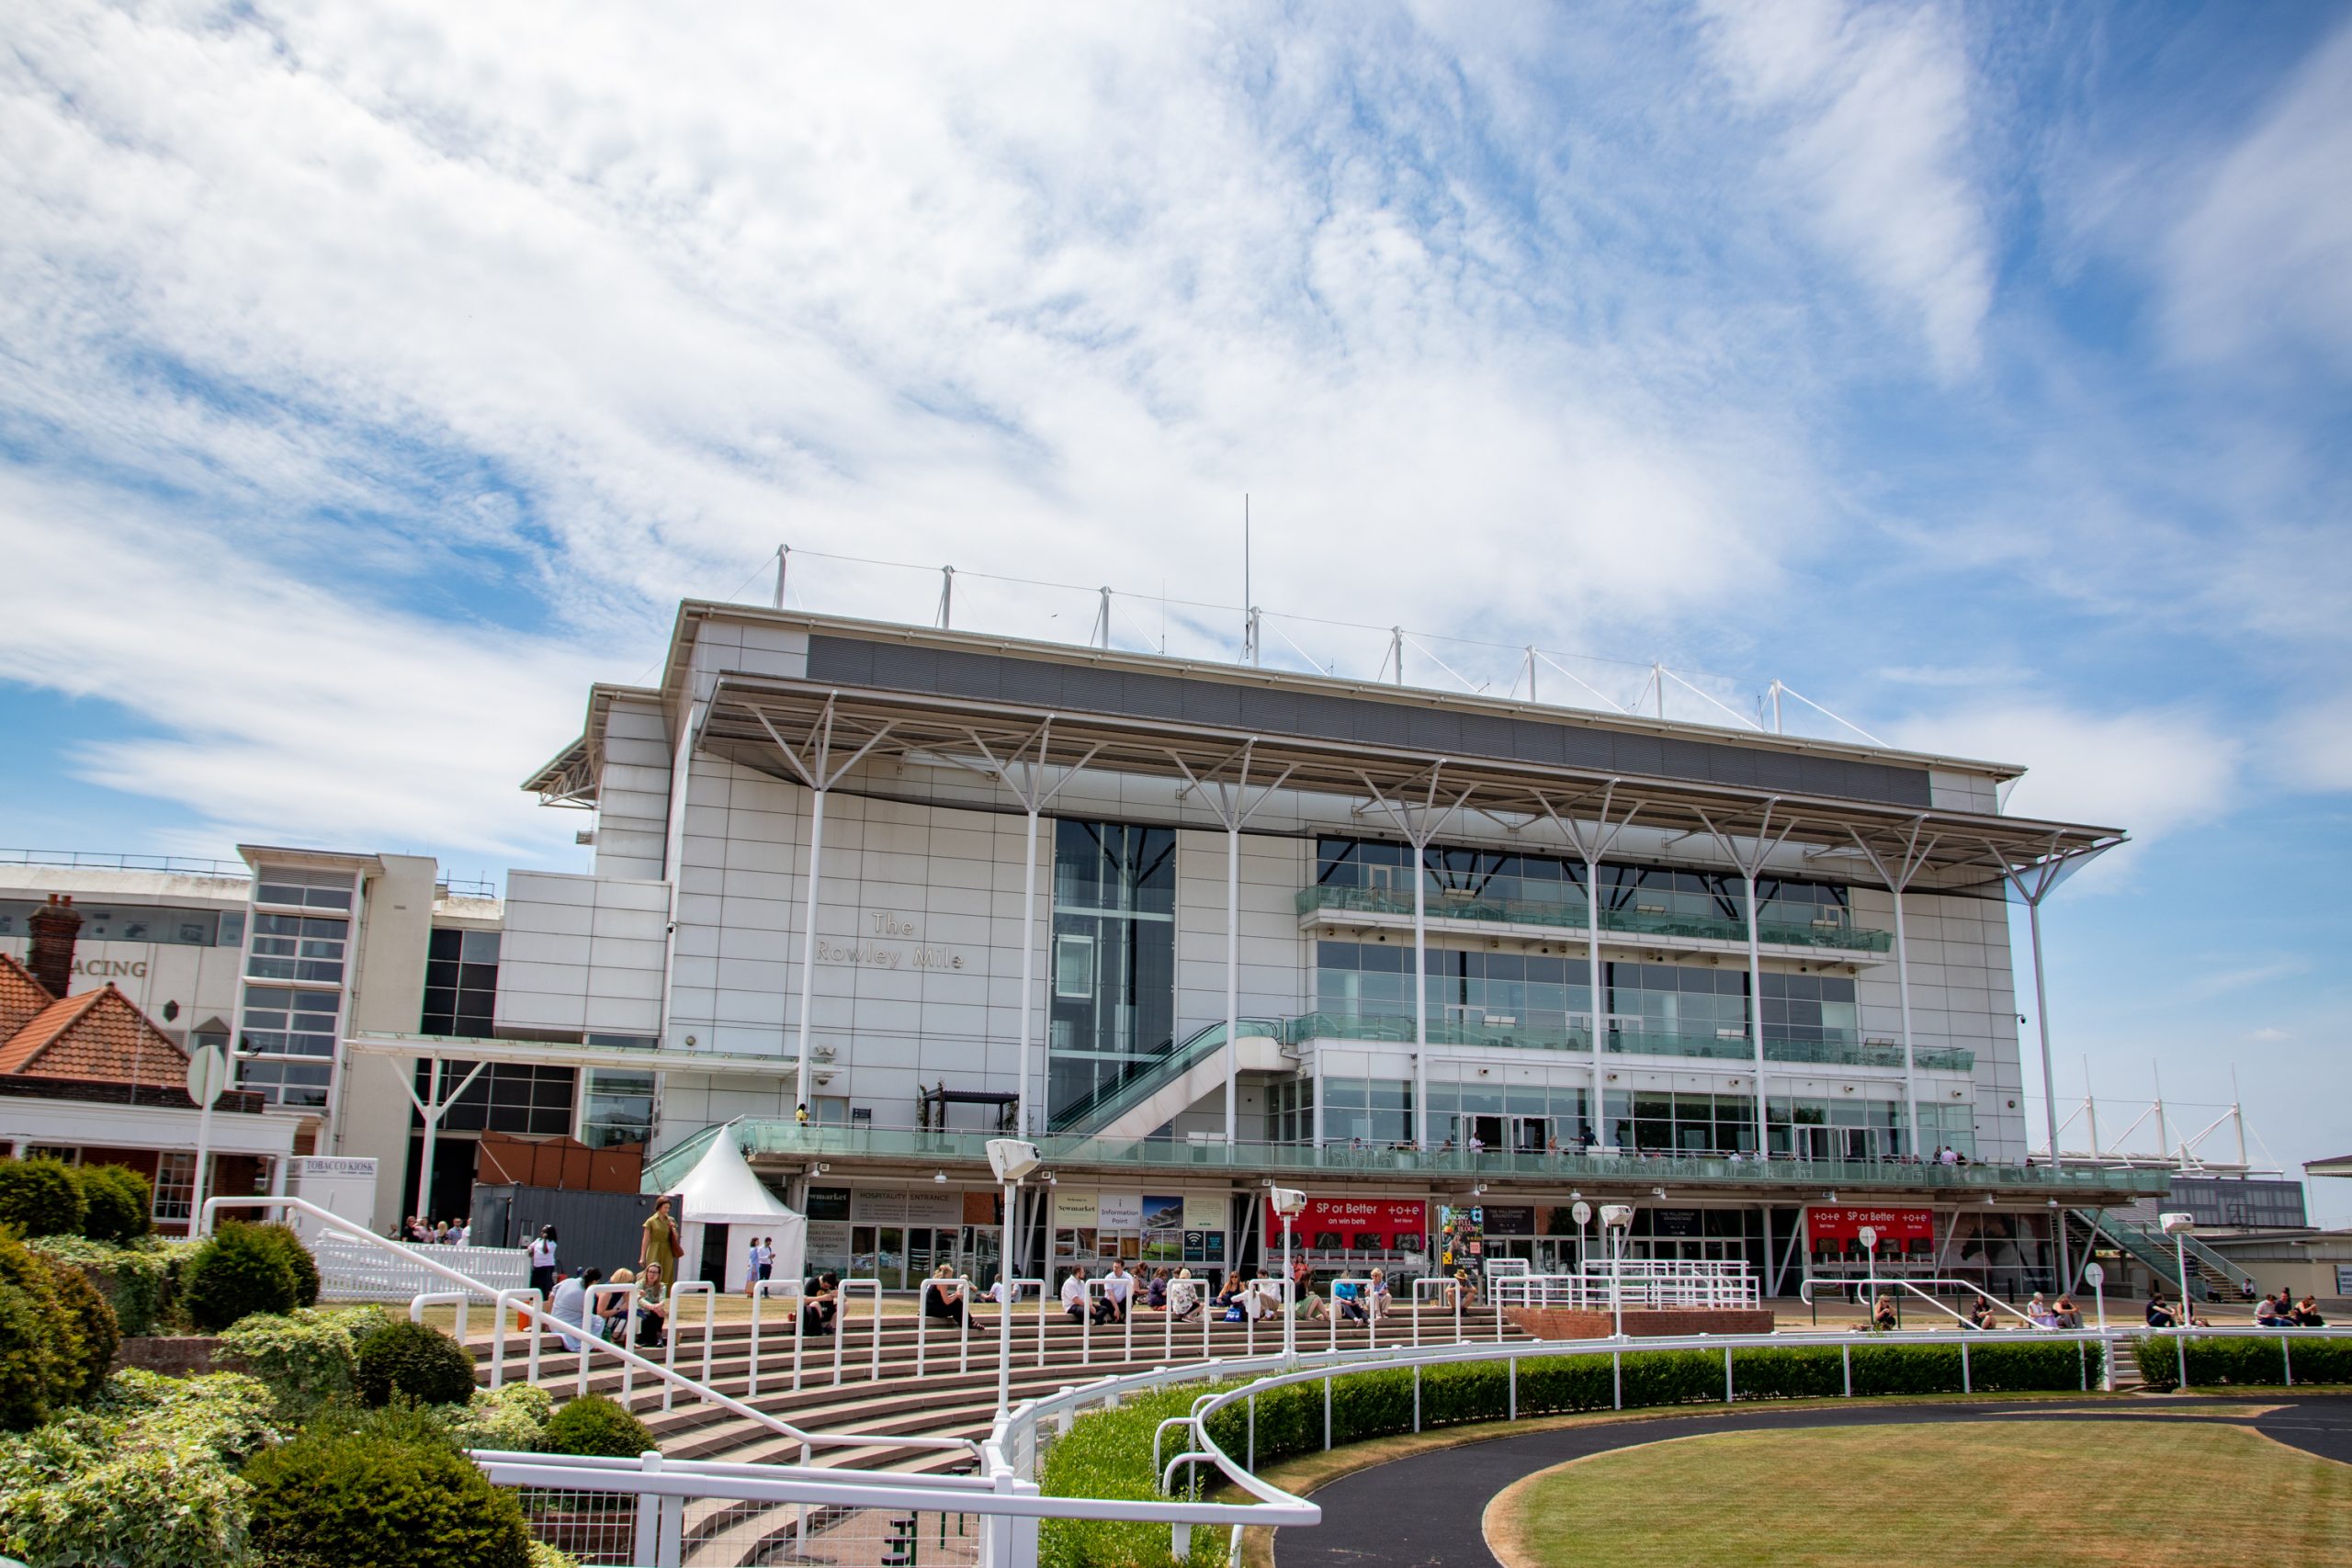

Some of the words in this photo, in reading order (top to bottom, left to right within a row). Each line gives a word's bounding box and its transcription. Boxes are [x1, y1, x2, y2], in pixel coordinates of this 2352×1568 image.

[872, 911, 914, 935] The
[817, 940, 901, 969] Rowley
[913, 947, 964, 969] Mile
[71, 959, 147, 977] ACING
[307, 1160, 345, 1170] TOBACCO
[348, 1162, 374, 1171] KIOSK
[808, 1193, 846, 1201] wmarket
[1316, 1202, 1329, 1213] SP
[1331, 1204, 1342, 1213] or
[1346, 1202, 1377, 1214] Better
[1351, 1217, 1366, 1225] bets
[1848, 1212, 1858, 1221] SP
[1860, 1213, 1869, 1221] or
[1871, 1212, 1895, 1222] Better
